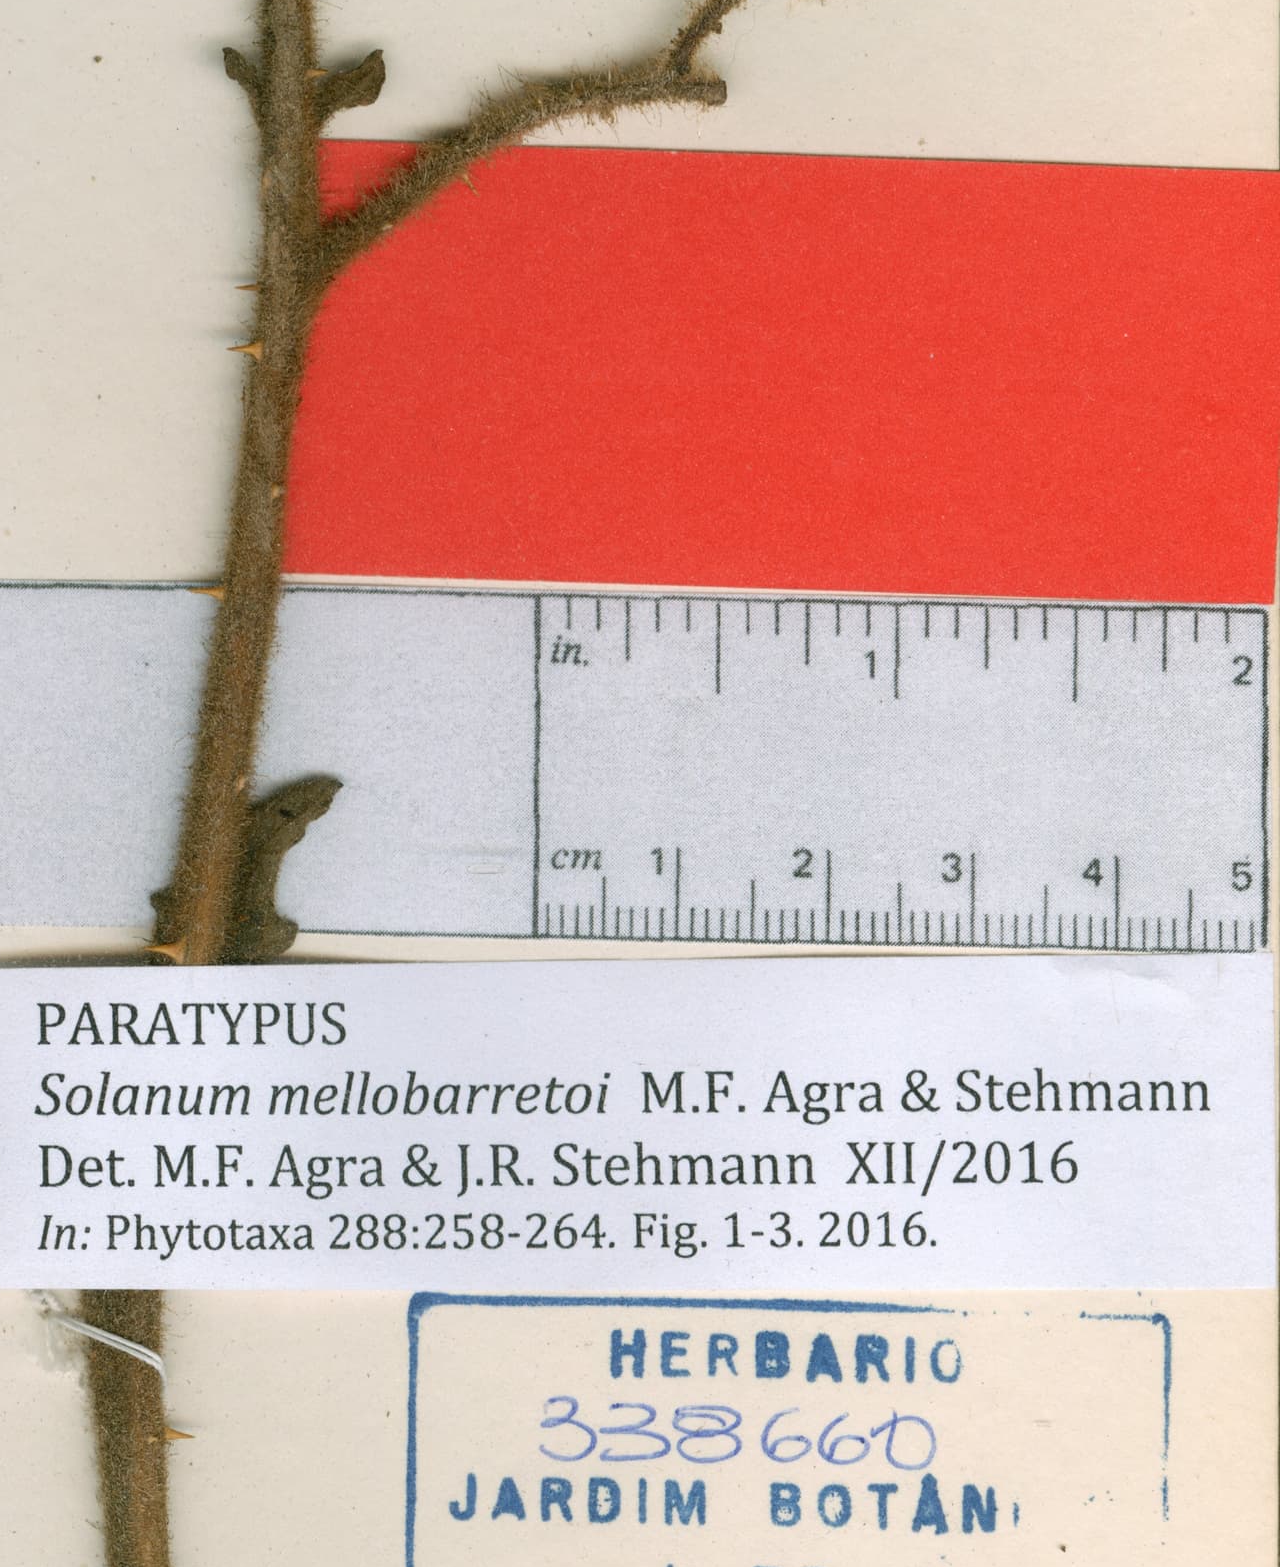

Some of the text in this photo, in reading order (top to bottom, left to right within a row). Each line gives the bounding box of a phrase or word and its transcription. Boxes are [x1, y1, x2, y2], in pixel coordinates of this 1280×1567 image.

[550, 636, 590, 665] in.
[864, 652, 1253, 684] 1 2
[551, 847, 1252, 890] cm 1 2 3 4 5
[37, 1002, 346, 1046] PARATYPUS
[34, 1067, 1210, 1125] Solanum mellobarretoi M.F. Agra & Stehmann
[38, 1140, 1078, 1200] Det. M.F. Agra & J.R. Stehmann XII/2016
[37, 1211, 936, 1261] In: Phytotaxa 288:258-264. Fig. 1-3. 2016.
[611, 1329, 963, 1384] HERBARIO
[539, 1396, 938, 1470] 338660
[450, 1474, 708, 1526] JARDIM
